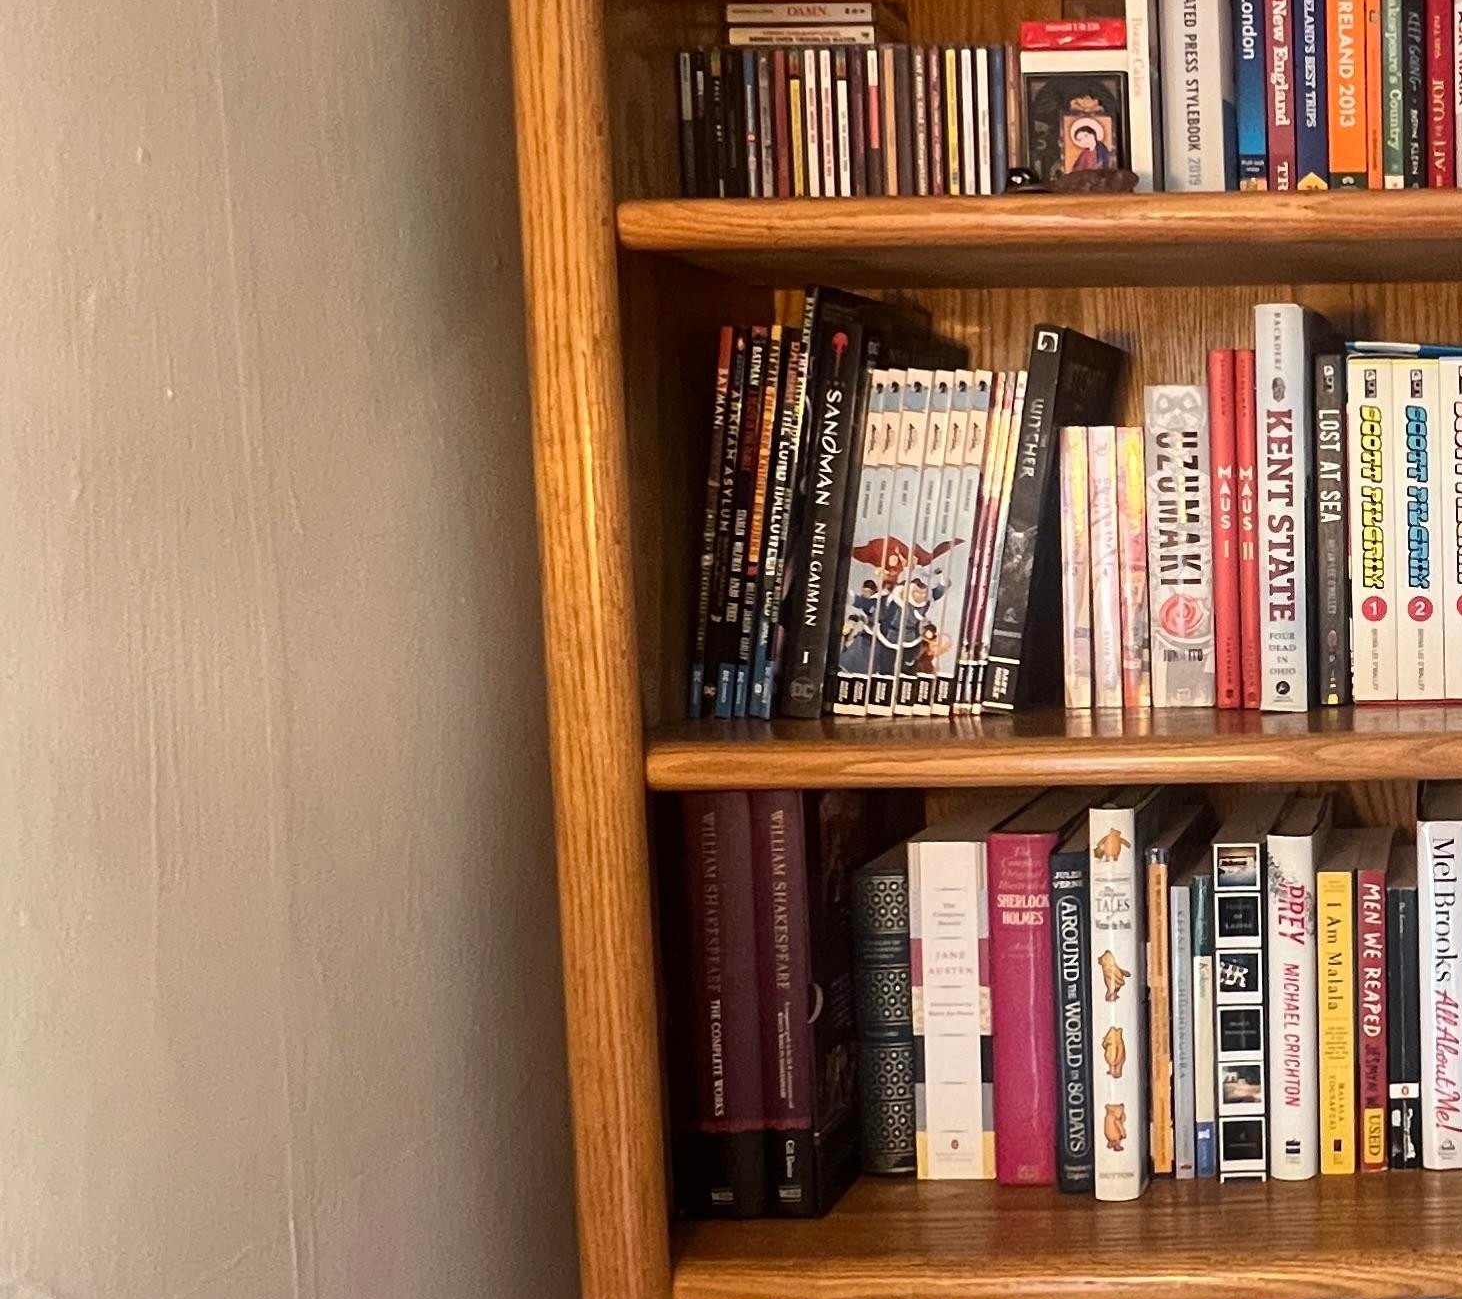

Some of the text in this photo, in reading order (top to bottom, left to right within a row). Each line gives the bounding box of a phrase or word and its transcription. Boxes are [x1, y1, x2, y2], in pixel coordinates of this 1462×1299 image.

[1184, 33, 1198, 74] PRESS
[1408, 11, 1422, 41] KEEP
[1270, 0, 1291, 127] New England
[1185, 79, 1201, 152] STYLEBOOK
[1339, 83, 1357, 128] 2013
[1387, 88, 1402, 151] Country
[1188, 156, 1202, 187] 2019
[1018, 397, 1045, 479] WITCHER
[1318, 408, 1342, 522] LOST AT SEA
[803, 388, 842, 628] SANDMAN NEIL GAIMAN
[1156, 431, 1204, 586] UZUMAKI
[1217, 464, 1232, 531] MAUS
[1238, 464, 1254, 532] MAUS
[1266, 407, 1296, 622] KENT STATE
[1359, 405, 1384, 589] SCOTT PILGRIM
[1405, 405, 1430, 589] SCOTT PILGRIM
[1414, 601, 1426, 617] 2
[1432, 837, 1458, 883] Mel
[770, 809, 791, 991] WILLIAM SHAKESPEARE
[996, 894, 1050, 909] SHERLOCK
[1002, 911, 1045, 926] HOLMES
[1326, 915, 1342, 945] Am
[1060, 900, 1081, 981] AROUND
[1362, 882, 1383, 1037] MEN WE REAPED
[1432, 891, 1458, 983] Brooks
[1277, 883, 1306, 1107] PREY MICHAEL CRICHTON
[1326, 950, 1344, 1011] Malala
[1433, 988, 1459, 1027] All
[1063, 1001, 1084, 1069] WORLD
[1434, 1029, 1460, 1087] About
[1066, 1080, 1086, 1105] 80
[1068, 1107, 1088, 1153] DAYS
[1368, 1113, 1382, 1157] USED
